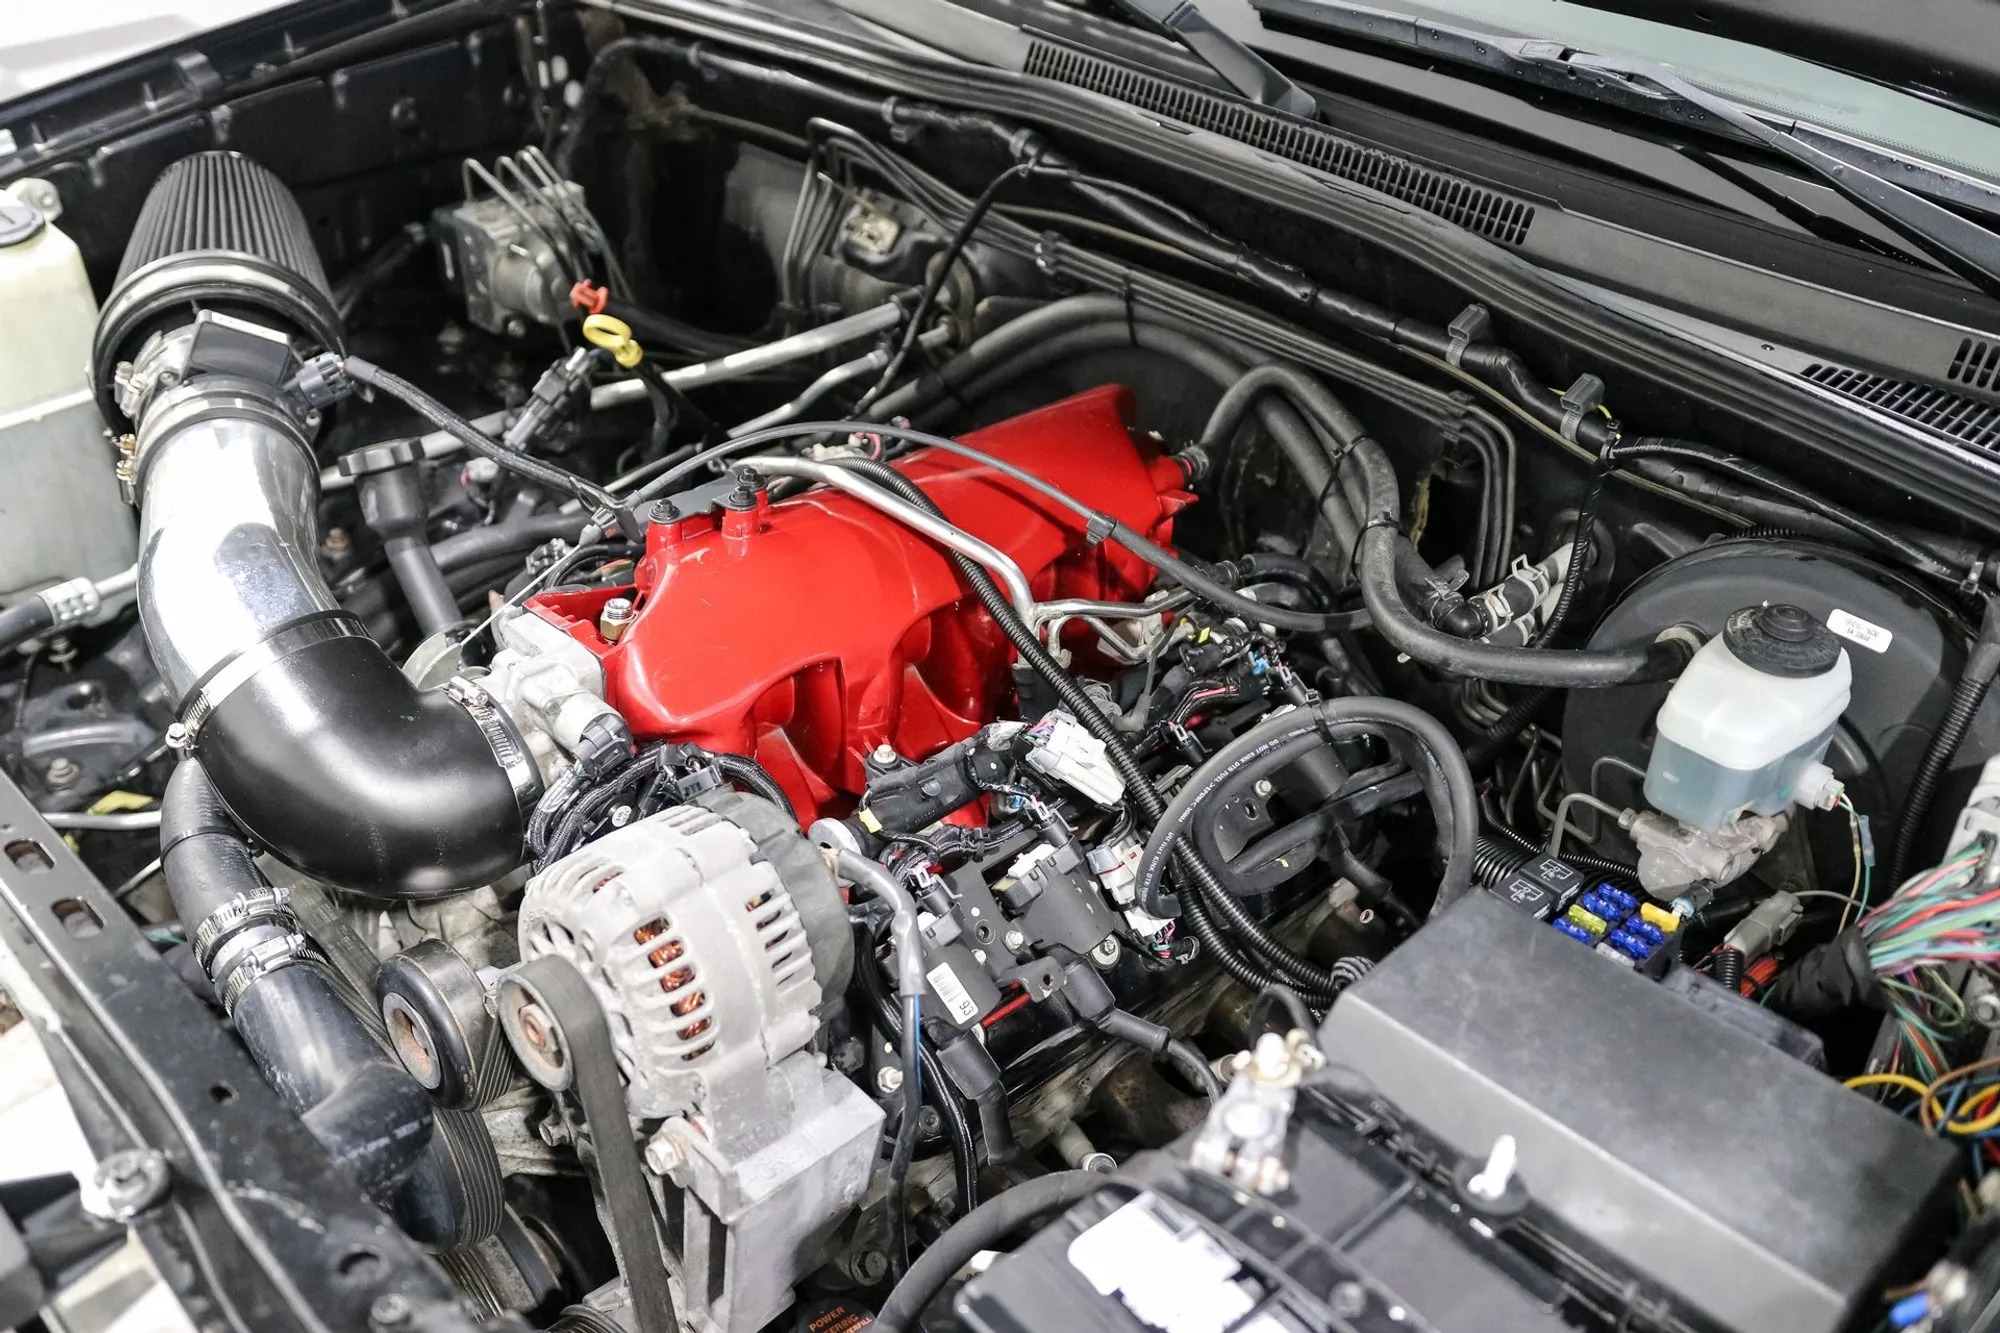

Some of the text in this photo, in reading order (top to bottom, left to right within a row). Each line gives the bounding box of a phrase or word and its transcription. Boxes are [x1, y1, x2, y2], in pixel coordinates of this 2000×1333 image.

[1255, 743, 1269, 754] NOT
[1239, 751, 1256, 764] KINK
[1213, 770, 1229, 784] FUEL
[959, 1000, 974, 1016] 93
[808, 1307, 845, 1332] POWER
